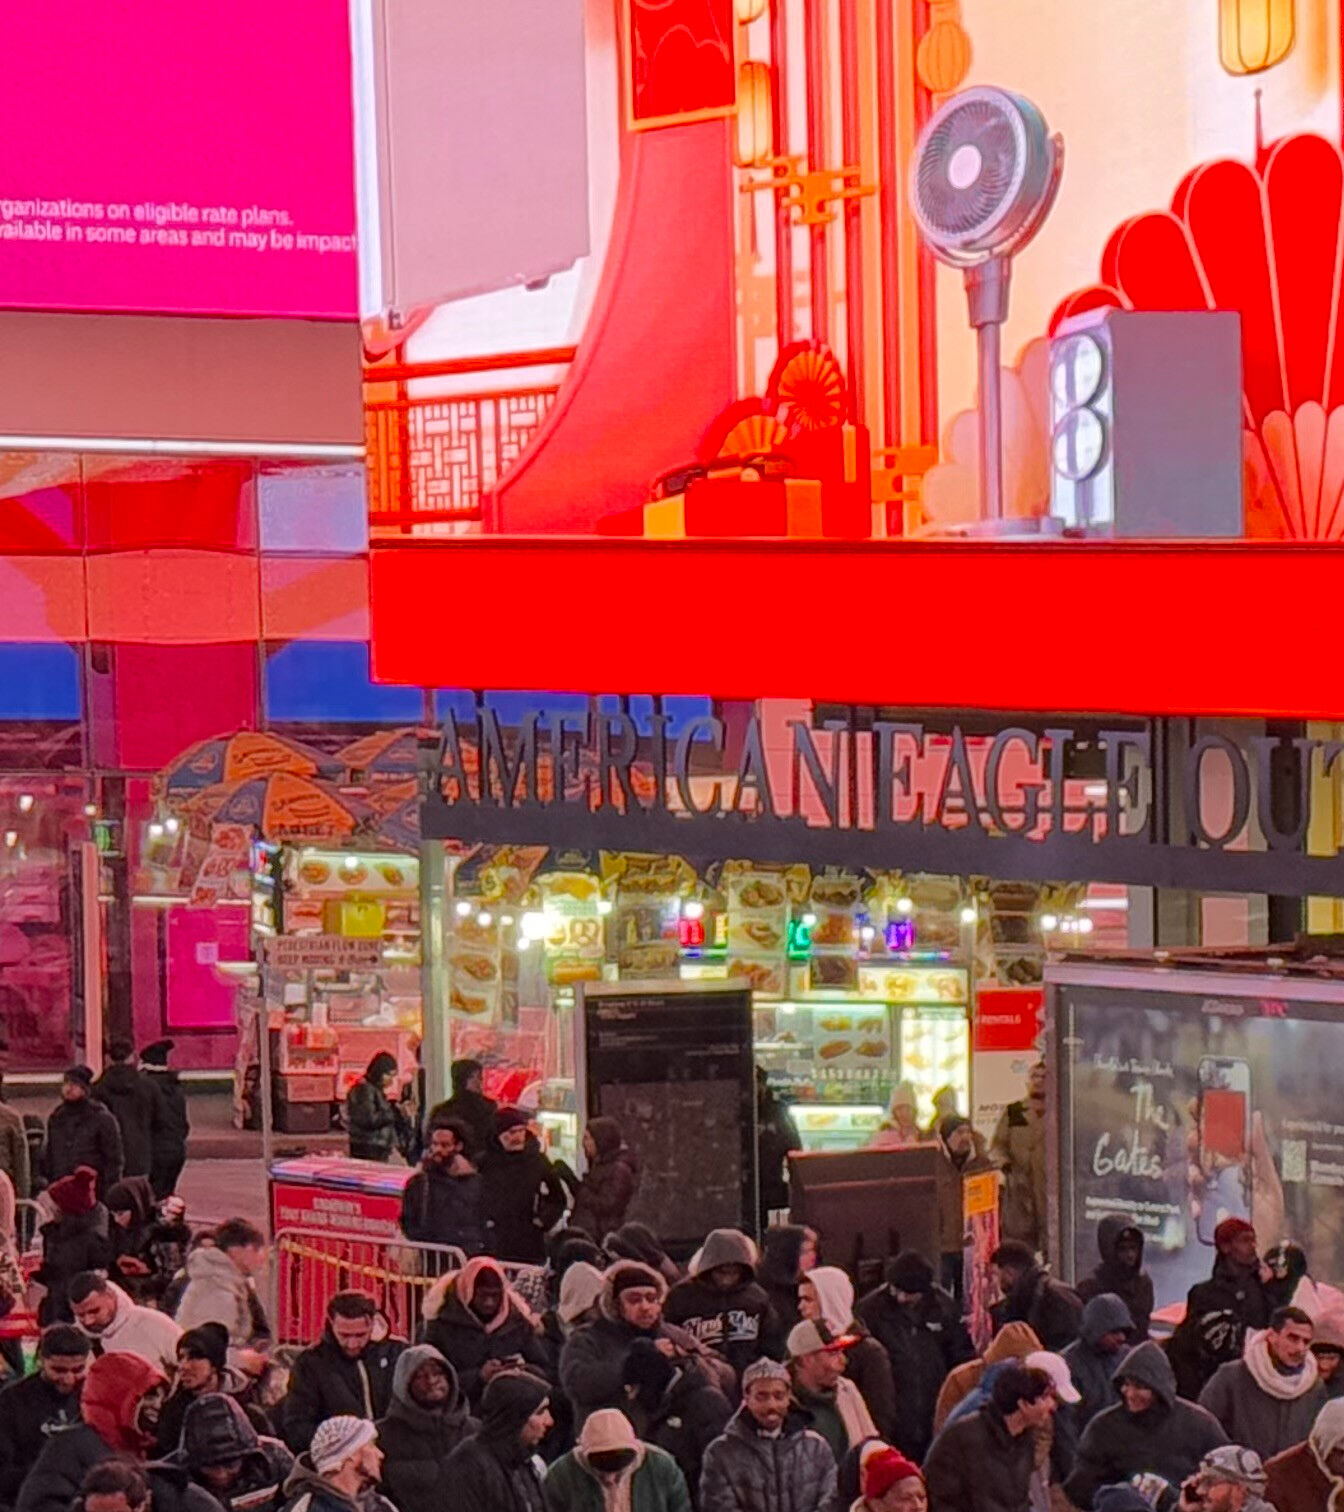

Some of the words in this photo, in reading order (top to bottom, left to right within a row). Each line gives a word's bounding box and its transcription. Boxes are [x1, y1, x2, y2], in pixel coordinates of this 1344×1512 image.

[0, 198, 104, 220] ganizations
[107, 203, 130, 219] on
[133, 202, 198, 226] eligible
[202, 206, 238, 223] rate
[241, 205, 294, 227] plans.
[0, 220, 62, 241] ailable
[66, 223, 83, 241] in
[86, 227, 136, 244] some
[139, 228, 188, 246] areas
[191, 228, 225, 247] and
[229, 232, 267, 252] may
[270, 230, 293, 249] be
[436, 702, 848, 830] AMERICAN
[872, 720, 1151, 840] EAGLE
[1131, 1078, 1171, 1130] The
[1092, 1130, 1164, 1179] Gates
